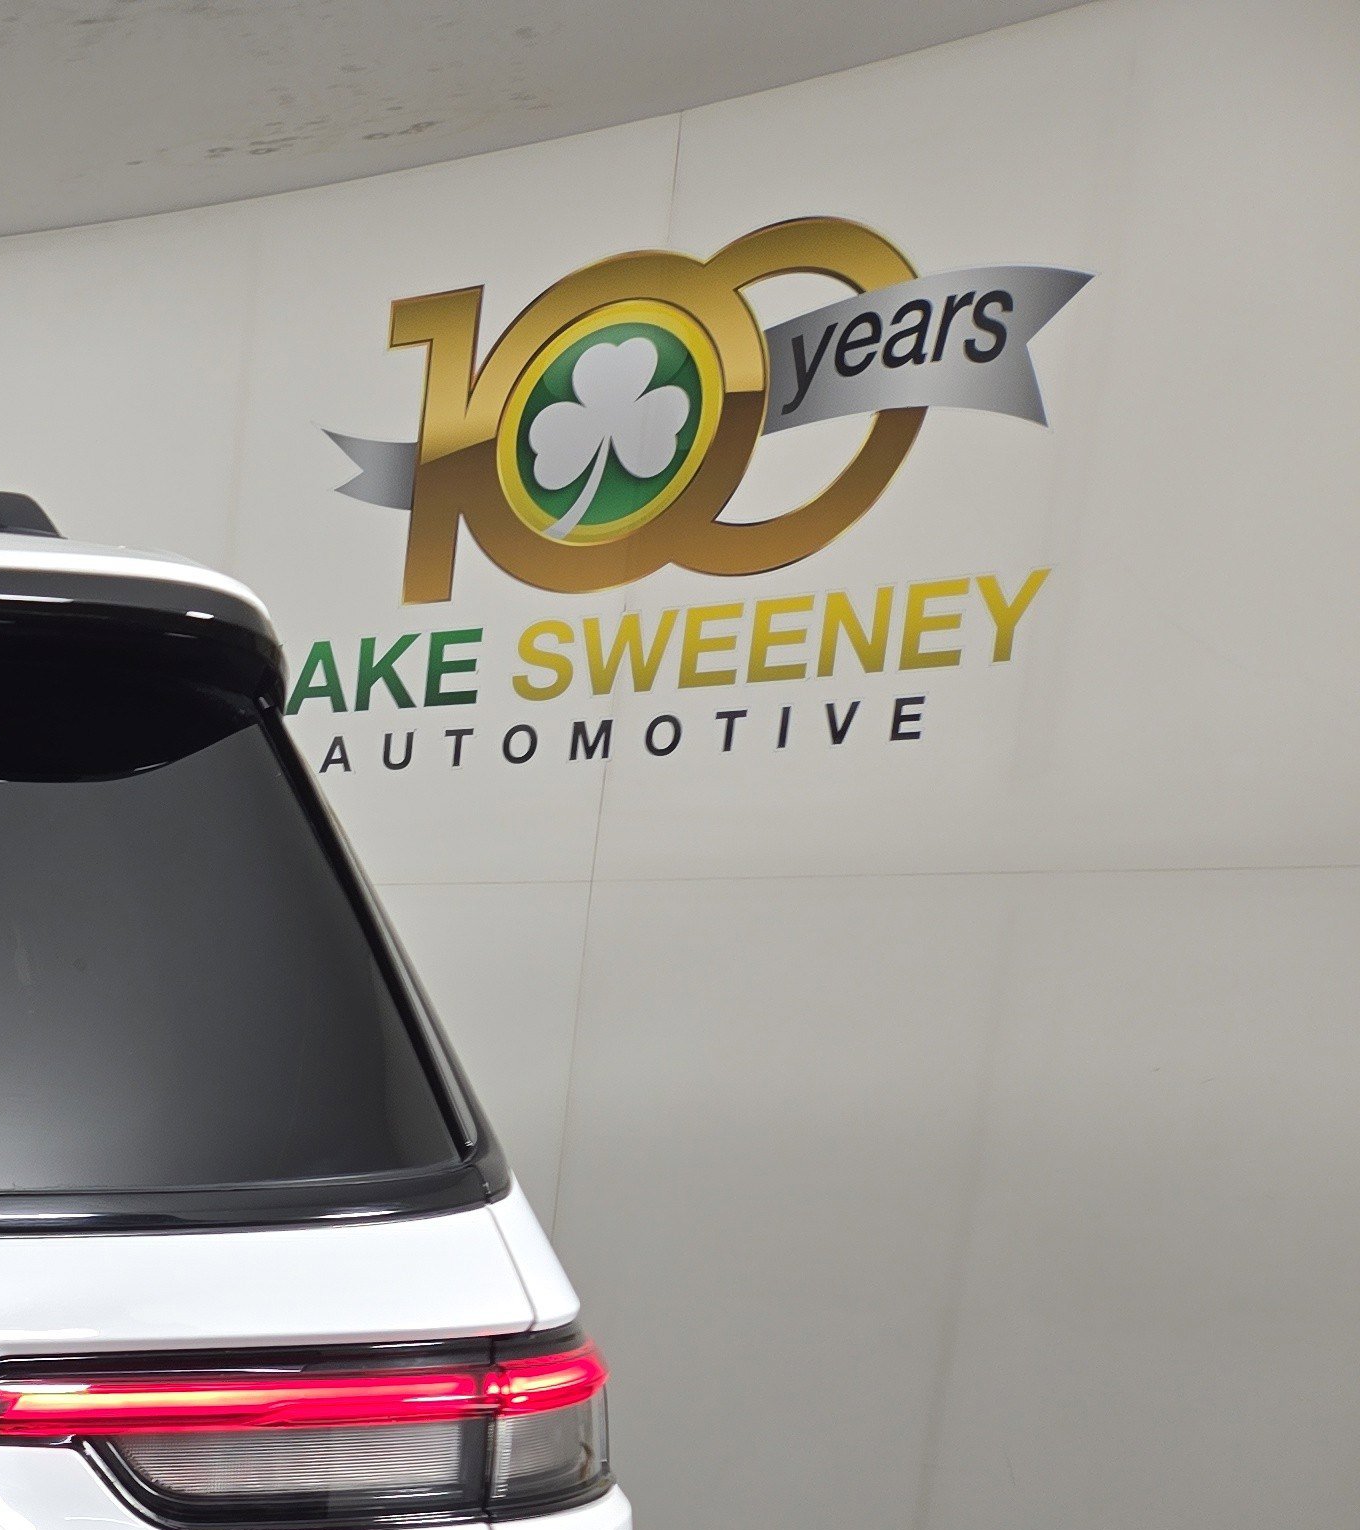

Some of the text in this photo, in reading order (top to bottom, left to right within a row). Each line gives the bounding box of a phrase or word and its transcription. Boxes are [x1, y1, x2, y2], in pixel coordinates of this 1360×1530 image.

[782, 287, 1015, 416] years
[280, 569, 1053, 716] AKE SWEENEY
[318, 695, 927, 775] AUTOMOTIVE
